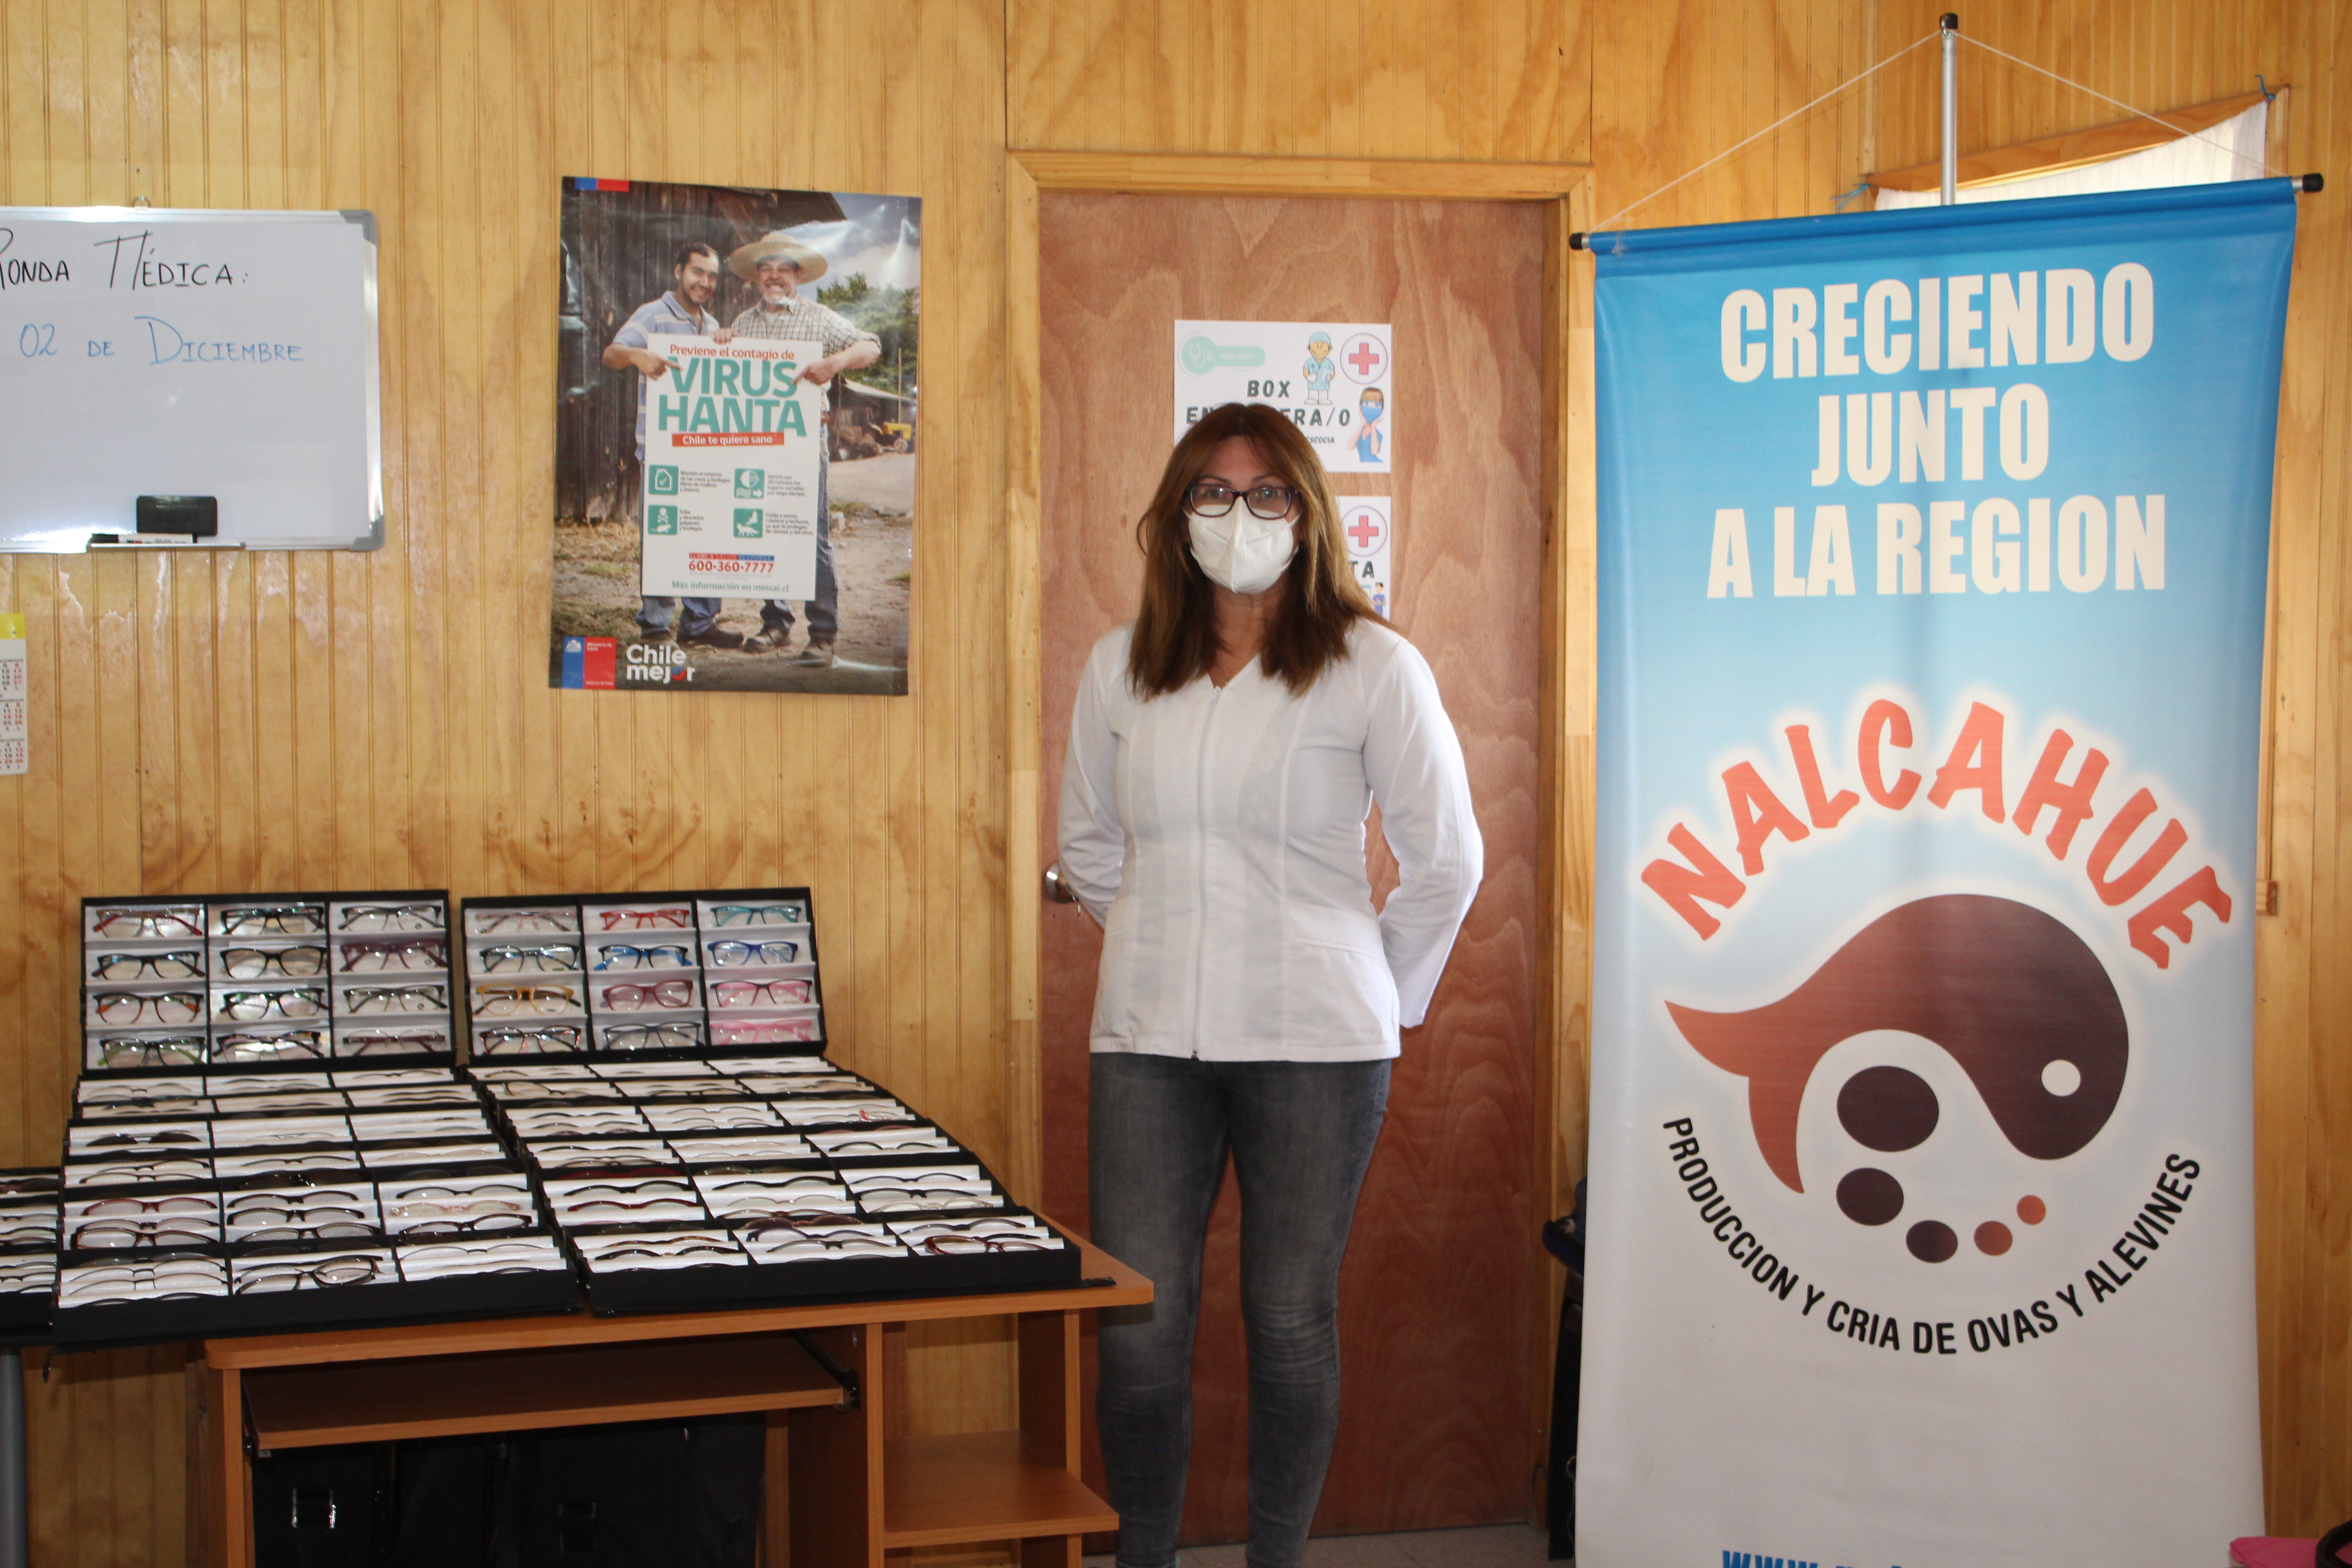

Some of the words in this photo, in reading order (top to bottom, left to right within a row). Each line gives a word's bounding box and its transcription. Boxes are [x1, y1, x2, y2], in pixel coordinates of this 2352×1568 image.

[20, 323, 58, 358] 02
[88, 340, 115, 357] DE
[1720, 262, 2154, 382] CRECIENDO
[669, 344, 717, 357] Previene
[719, 347, 729, 358] el
[732, 348, 779, 361] contagio
[781, 350, 795, 360] de
[667, 356, 798, 398] VIRUS
[1247, 379, 1290, 397] BOX
[658, 394, 807, 437] HANTA
[1811, 383, 2049, 486] JUNTO
[682, 435, 706, 445] Chile
[708, 436, 718, 445] te
[719, 435, 749, 446] quiere
[750, 435, 773, 444] sano
[1706, 508, 1754, 599] A
[1773, 505, 1857, 597] LA
[1876, 494, 2165, 595] REGION
[671, 580, 688, 589] Más
[690, 581, 740, 591] información
[626, 643, 686, 666] Chile
[1641, 698, 2233, 970] NALCAHUE
[1663, 1117, 1799, 1301] PRODUCCION
[1802, 1284, 1825, 1316] Y
[1827, 1300, 1900, 1351] CRIA
[1913, 1322, 1957, 1355] DE
[1967, 1300, 2058, 1352] OVAS
[2056, 1284, 2083, 1317] Y
[2084, 1154, 2200, 1303] ALEVINES
